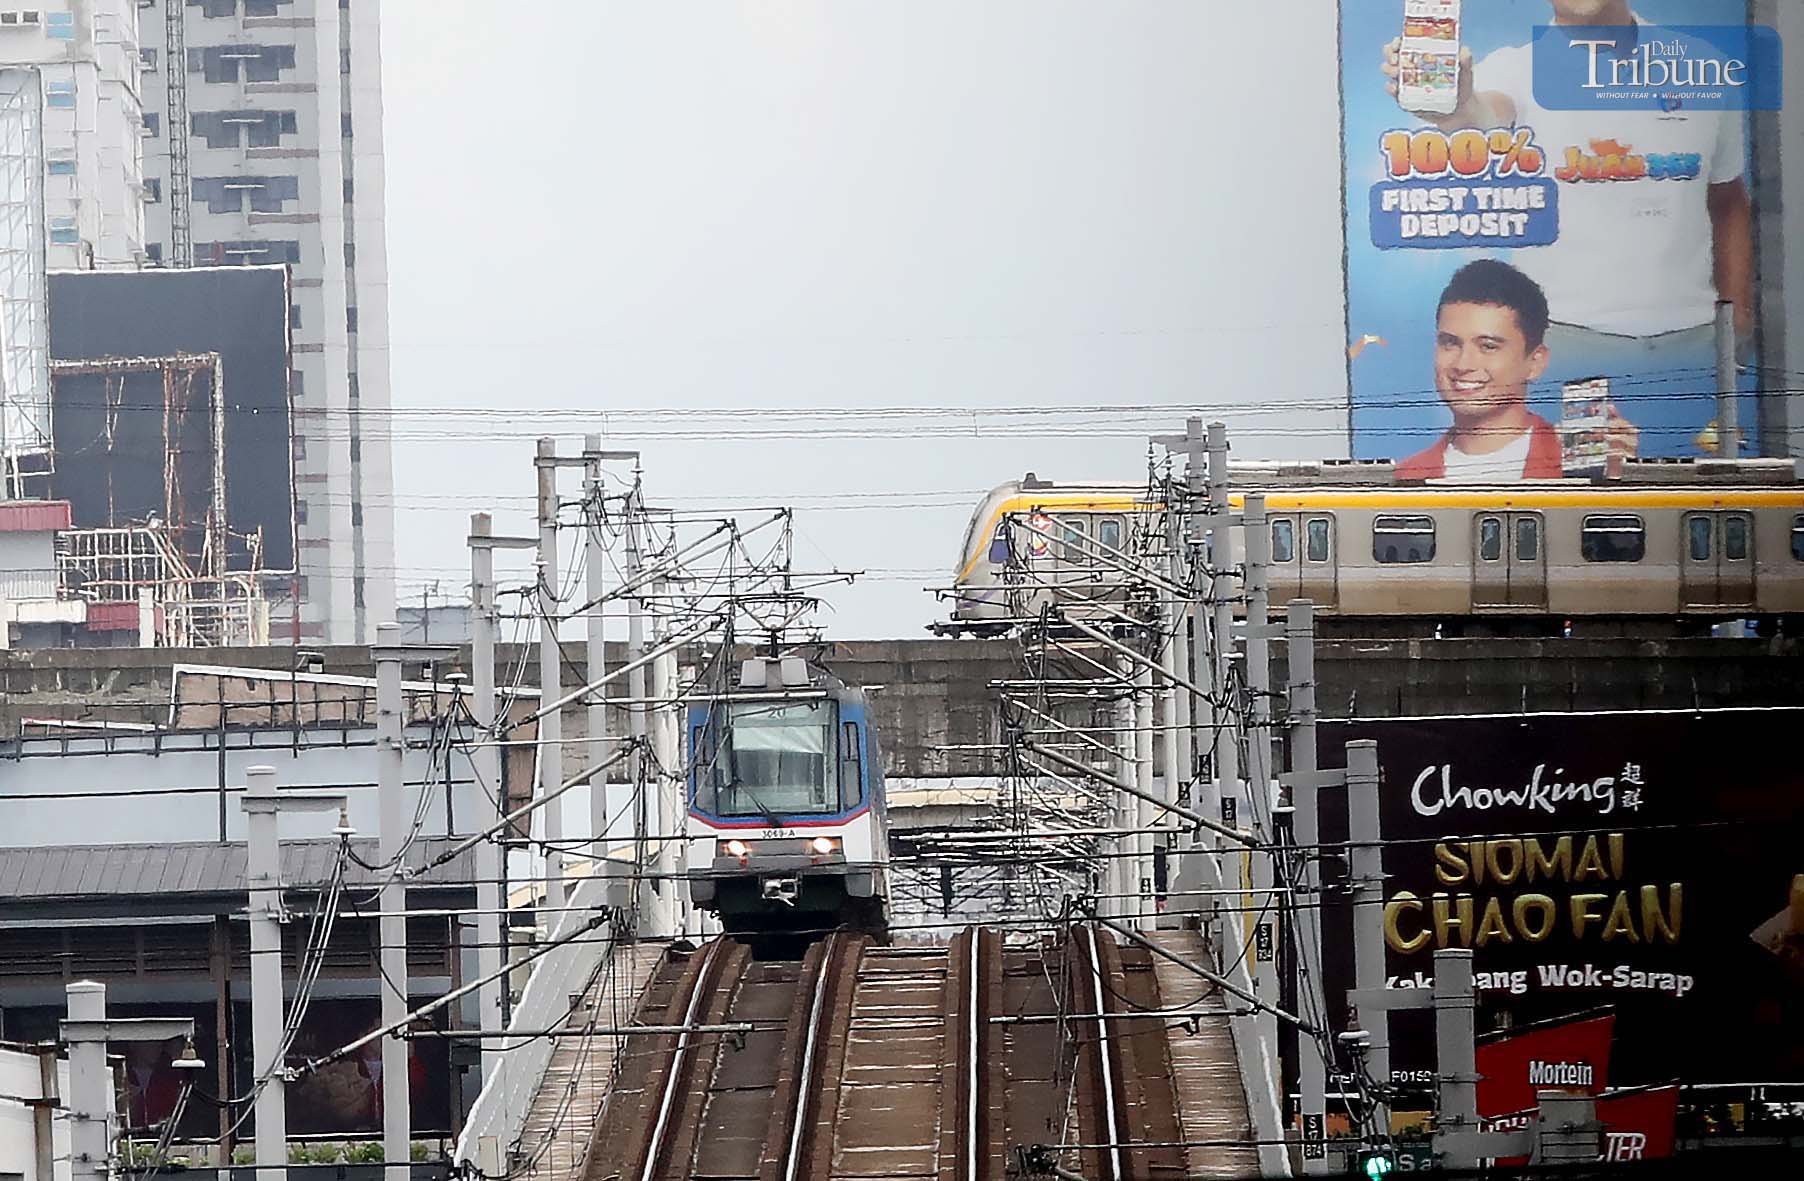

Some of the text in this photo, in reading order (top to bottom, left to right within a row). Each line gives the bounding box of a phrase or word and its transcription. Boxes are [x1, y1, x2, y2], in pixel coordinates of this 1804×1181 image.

[1383, 129, 1543, 178] 100%
[1382, 185, 1545, 212] FIRST TIME
[1401, 213, 1529, 237] DEPOSIT
[1411, 764, 1615, 816] Chowking
[1434, 833, 1624, 885] SIOMAI
[1384, 882, 1682, 953] CHAO FAN
[1537, 964, 1694, 997] Wok-Sarap
[1529, 1060, 1593, 1085] Mortein
[1598, 1132, 1646, 1162] TER
